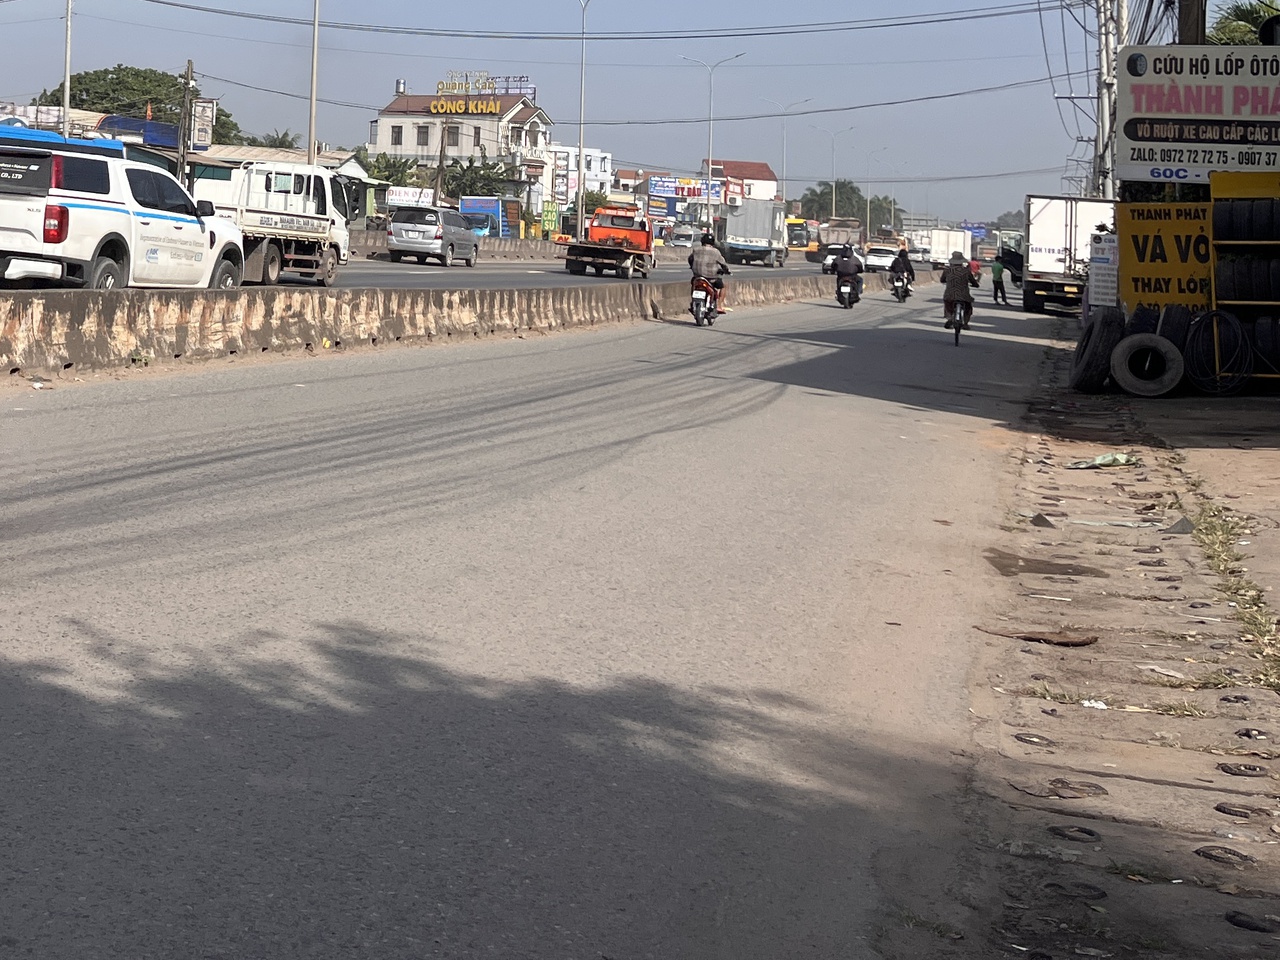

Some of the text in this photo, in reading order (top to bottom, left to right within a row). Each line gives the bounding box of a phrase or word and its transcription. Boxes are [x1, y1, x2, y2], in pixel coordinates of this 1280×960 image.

[1153, 52, 1280, 79] CỨU HỘ LỐP ÔTÔ
[1130, 77, 1224, 115] THÀNH
[1137, 120, 1151, 138] VỎ
[1153, 122, 1180, 141] RUỘT
[1183, 125, 1197, 138] XE
[1199, 126, 1220, 140] CAO
[1222, 122, 1244, 141] CẤP
[1247, 124, 1269, 141] CÁC
[1130, 147, 1158, 162] ZALO:
[1160, 148, 1184, 163] 0972
[1186, 149, 1199, 163] 72
[1201, 150, 1213, 164] 72
[1216, 150, 1228, 165] 75
[1238, 151, 1262, 166] 0907
[1265, 152, 1278, 166] 37
[1150, 167, 1189, 179] 60C
[543, 202, 557, 211] BAO
[543, 212, 556, 221] CAO
[544, 222, 555, 230] SU
[1131, 226, 1210, 264] VÁ VỎ
[1131, 277, 1172, 293] THAY
